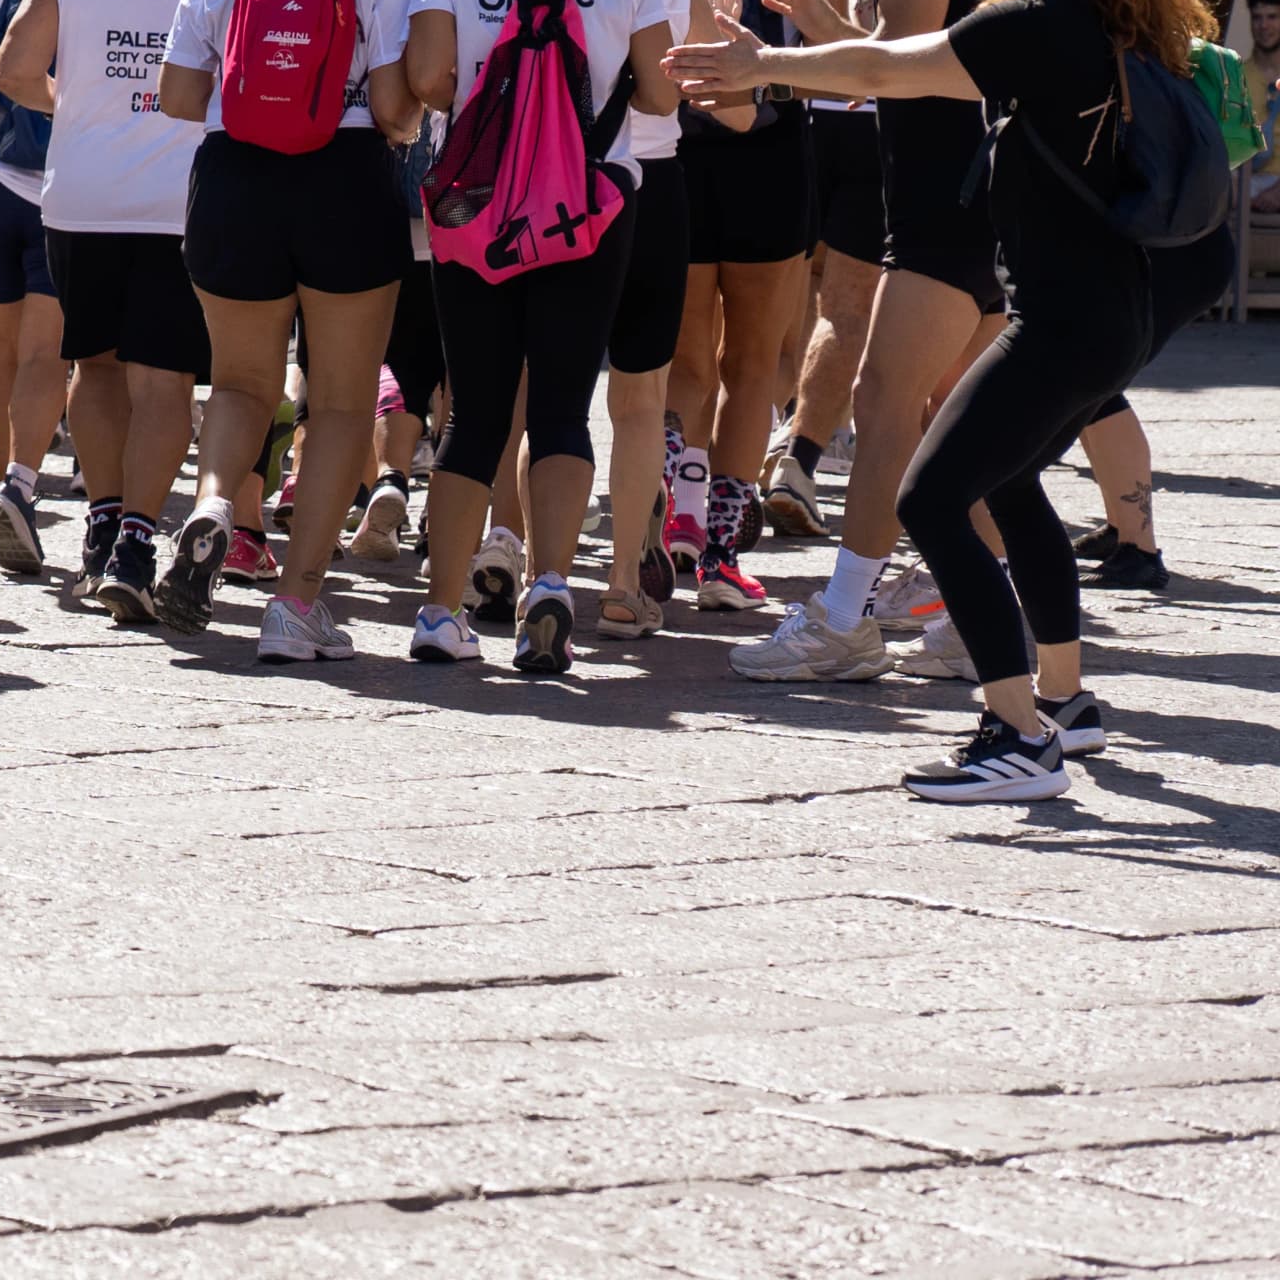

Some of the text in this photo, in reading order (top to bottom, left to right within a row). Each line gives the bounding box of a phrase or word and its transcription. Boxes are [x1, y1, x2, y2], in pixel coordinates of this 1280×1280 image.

[478, 13, 507, 24] Pales
[106, 29, 170, 49] PALES
[106, 51, 140, 64] CITY
[105, 65, 148, 80] COLLI
[131, 91, 162, 113] CRO
